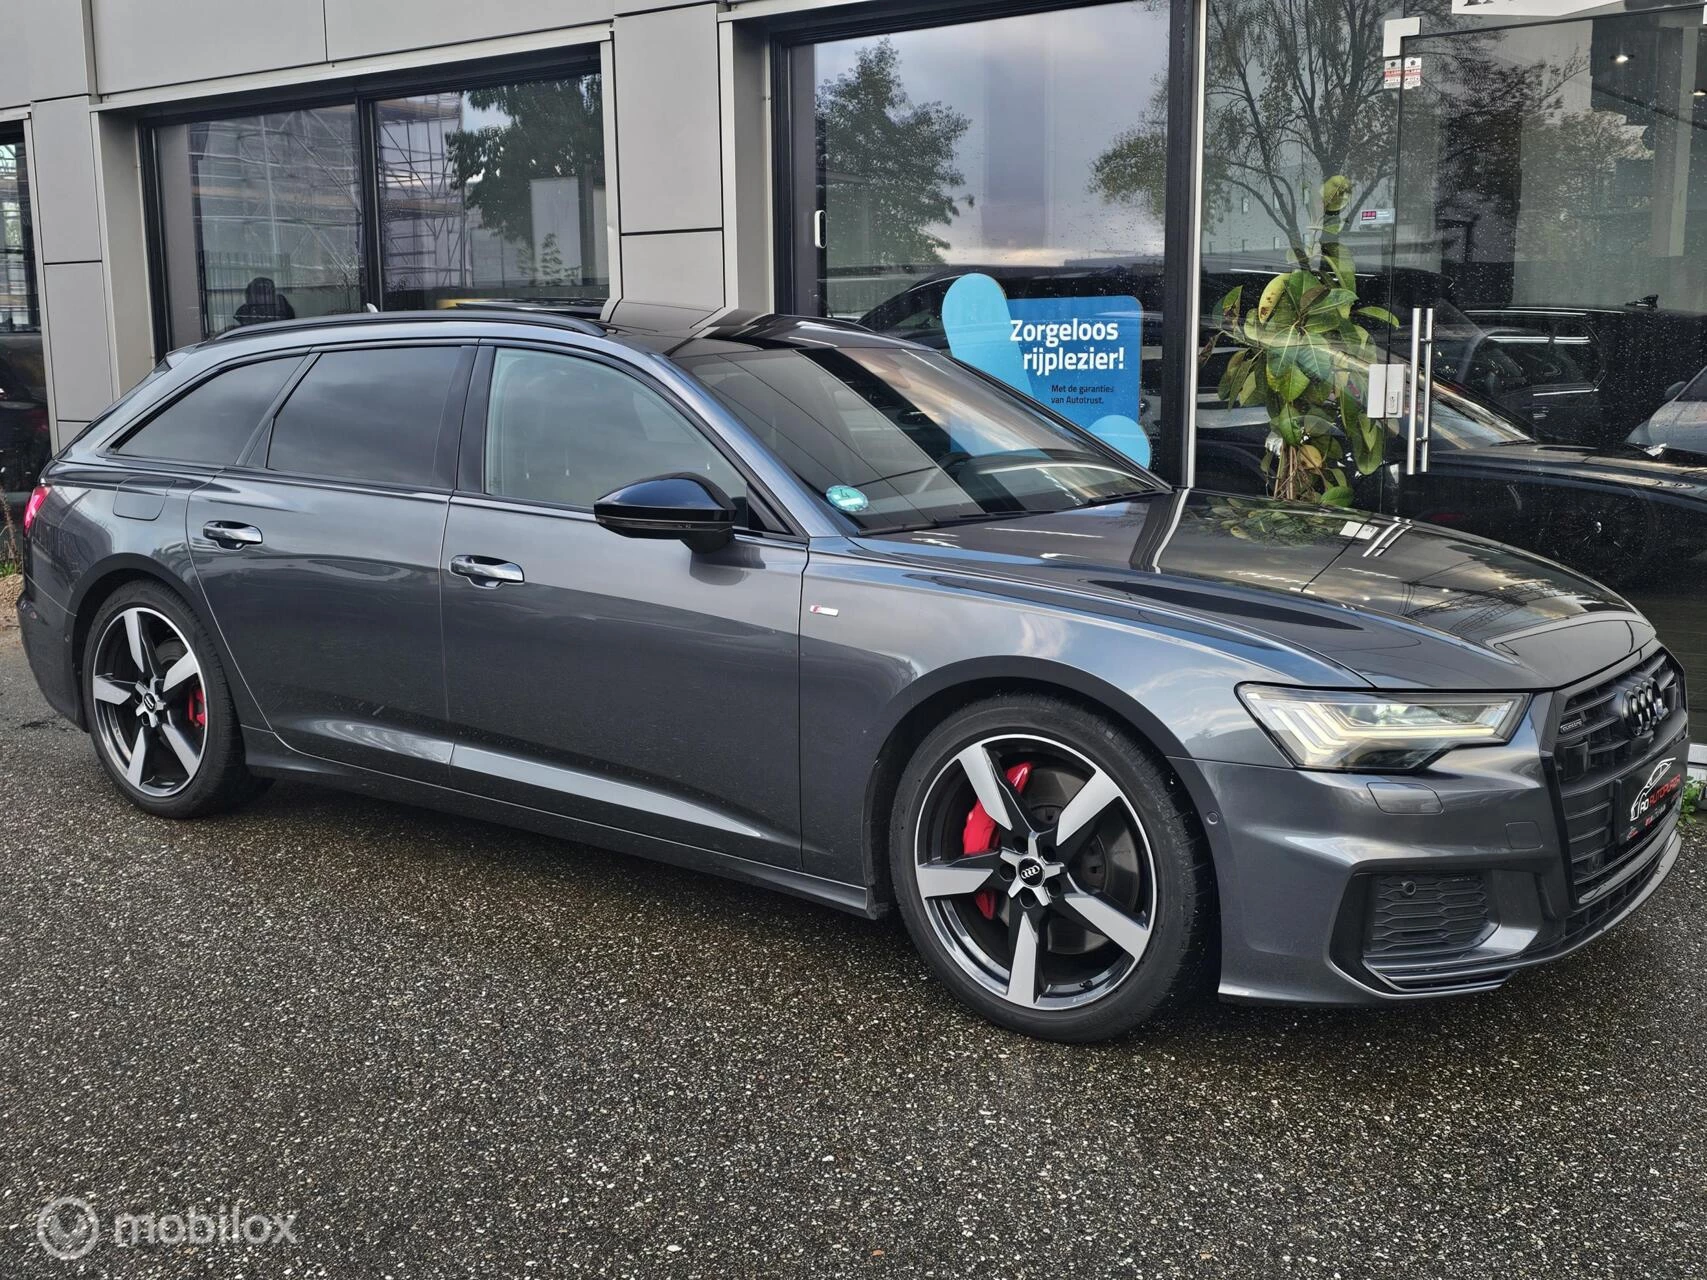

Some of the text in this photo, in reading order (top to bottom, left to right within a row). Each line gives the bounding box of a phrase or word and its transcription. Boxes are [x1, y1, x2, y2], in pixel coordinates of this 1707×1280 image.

[1009, 318, 1119, 348] Zorgeloos
[1023, 346, 1125, 376] rijplezier!
[1051, 384, 1114, 395] Met de garanties
[1066, 396, 1104, 405] Autotrust.
